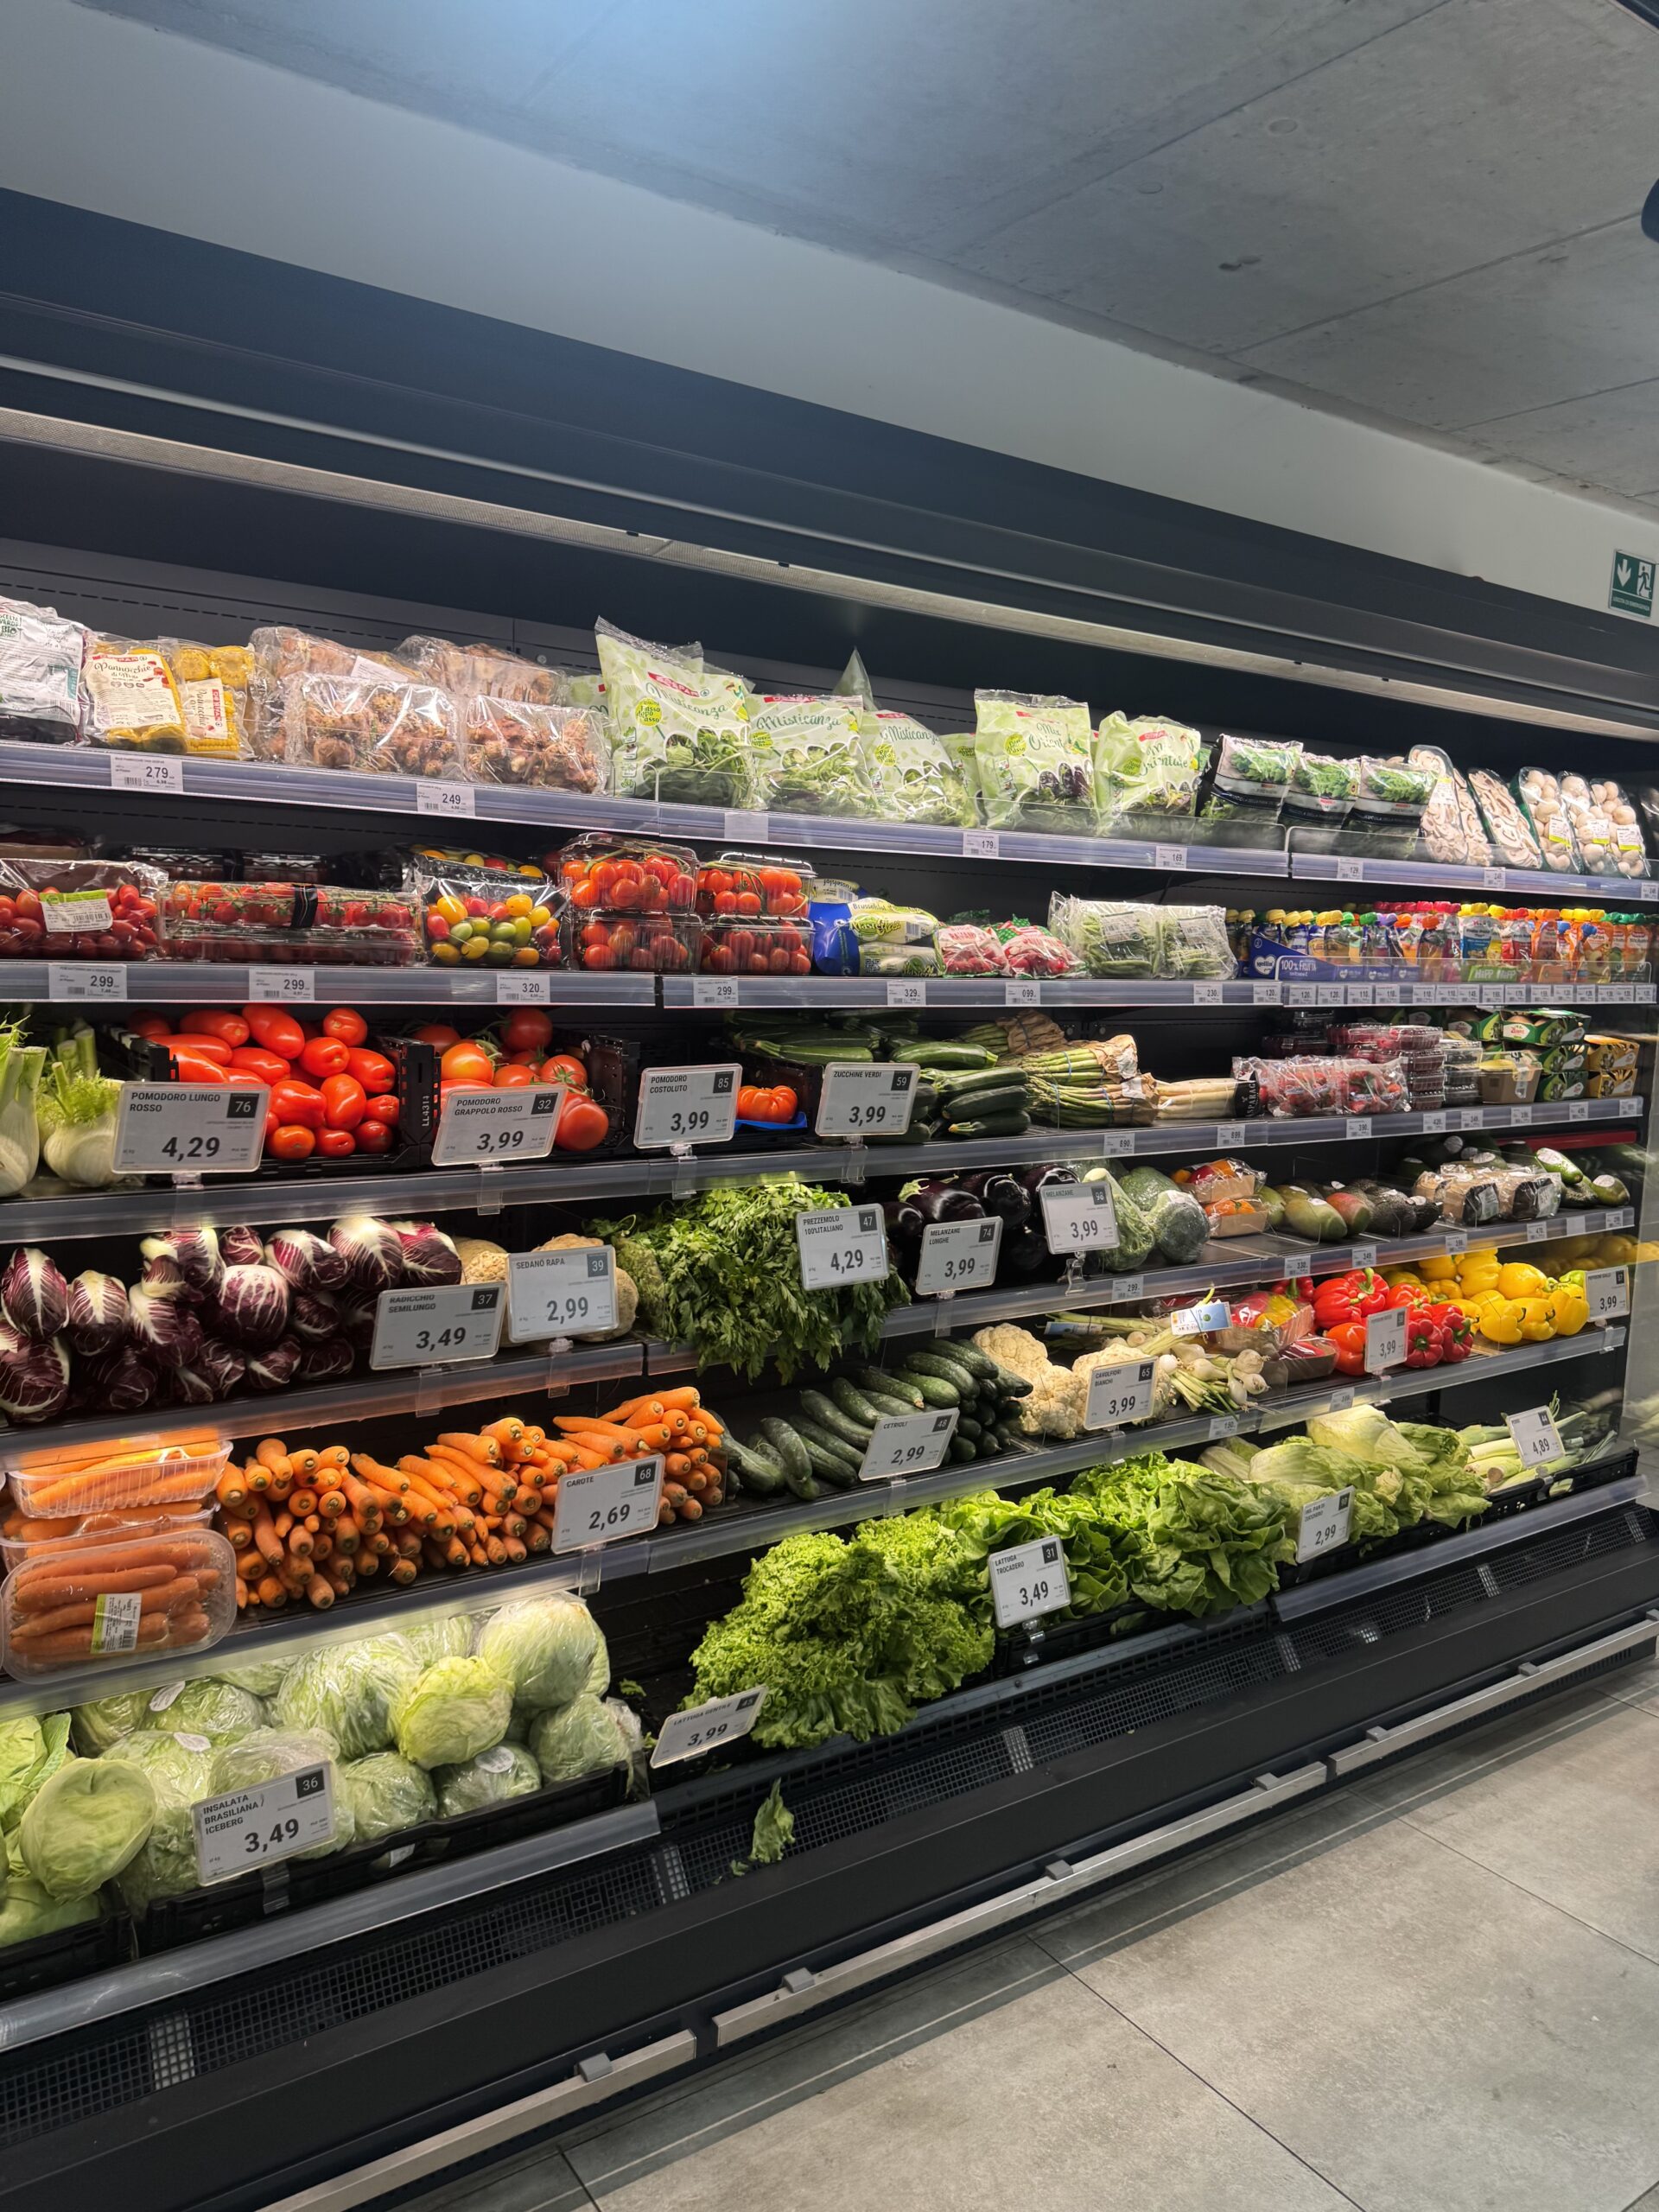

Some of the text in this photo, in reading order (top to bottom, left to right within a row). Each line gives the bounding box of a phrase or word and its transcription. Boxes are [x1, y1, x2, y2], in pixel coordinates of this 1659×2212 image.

[756, 714, 842, 731] Misticanza
[651, 1075, 688, 1084] POMODORO
[717, 1077, 729, 1088] 85
[896, 1077, 907, 1086] 59
[650, 1085, 688, 1094] COSTOLUTO
[131, 1092, 220, 1102] POMODORO LUNGO
[537, 1099, 550, 1109] 32
[130, 1103, 162, 1112] ROSSO
[235, 1101, 251, 1113] 76
[454, 1105, 523, 1116] GRAPPOLO ROSSO
[670, 1110, 709, 1135] 3,99
[849, 1106, 886, 1127] 3,99
[162, 1136, 220, 1161] 4,29
[476, 1130, 524, 1153] 3,99
[803, 1215, 840, 1226] PREZZEMOLO
[863, 1216, 873, 1226] 47
[930, 1228, 961, 1236] MELANZANE
[982, 1229, 992, 1238] 74
[1071, 1219, 1098, 1241] 3,99
[516, 1259, 544, 1269] SEDANO
[591, 1260, 604, 1272] 39
[830, 1249, 864, 1274] 4,29
[944, 1257, 976, 1280] 3,99
[390, 1294, 435, 1304] RADICCHIO
[477, 1294, 493, 1305] 37
[1599, 1295, 1618, 1312] 3,99
[388, 1303, 436, 1313] SEMILUNGO
[546, 1296, 588, 1325] 2,99
[416, 1326, 467, 1351] 3,49
[1379, 1339, 1396, 1358] 3,99
[1095, 1369, 1122, 1379] CAVOLFIORI
[1141, 1368, 1150, 1377] 65
[1109, 1395, 1136, 1417] 3,99
[883, 1421, 909, 1429] CETRIOLI
[1532, 1438, 1550, 1456] 4,89
[891, 1446, 925, 1465] 2,99
[639, 1468, 652, 1480] 68
[567, 1476, 594, 1487] CAROTE
[588, 1503, 631, 1530] 2,69
[1315, 1524, 1337, 1546] 2,99
[995, 1554, 1017, 1567] LATTUGA
[1046, 1548, 1055, 1559] 31
[996, 1561, 1025, 1575] TROCADERO
[1020, 1580, 1049, 1607] 3,49
[674, 1712, 704, 1726] LATTUGA
[687, 1723, 728, 1746] 3,99
[302, 1777, 318, 1791] 36
[202, 1794, 249, 1815] INSALATA
[204, 1802, 259, 1825] BRASILIANA
[206, 1816, 244, 1835] ICEBERG
[244, 1818, 300, 1853] 3,49
